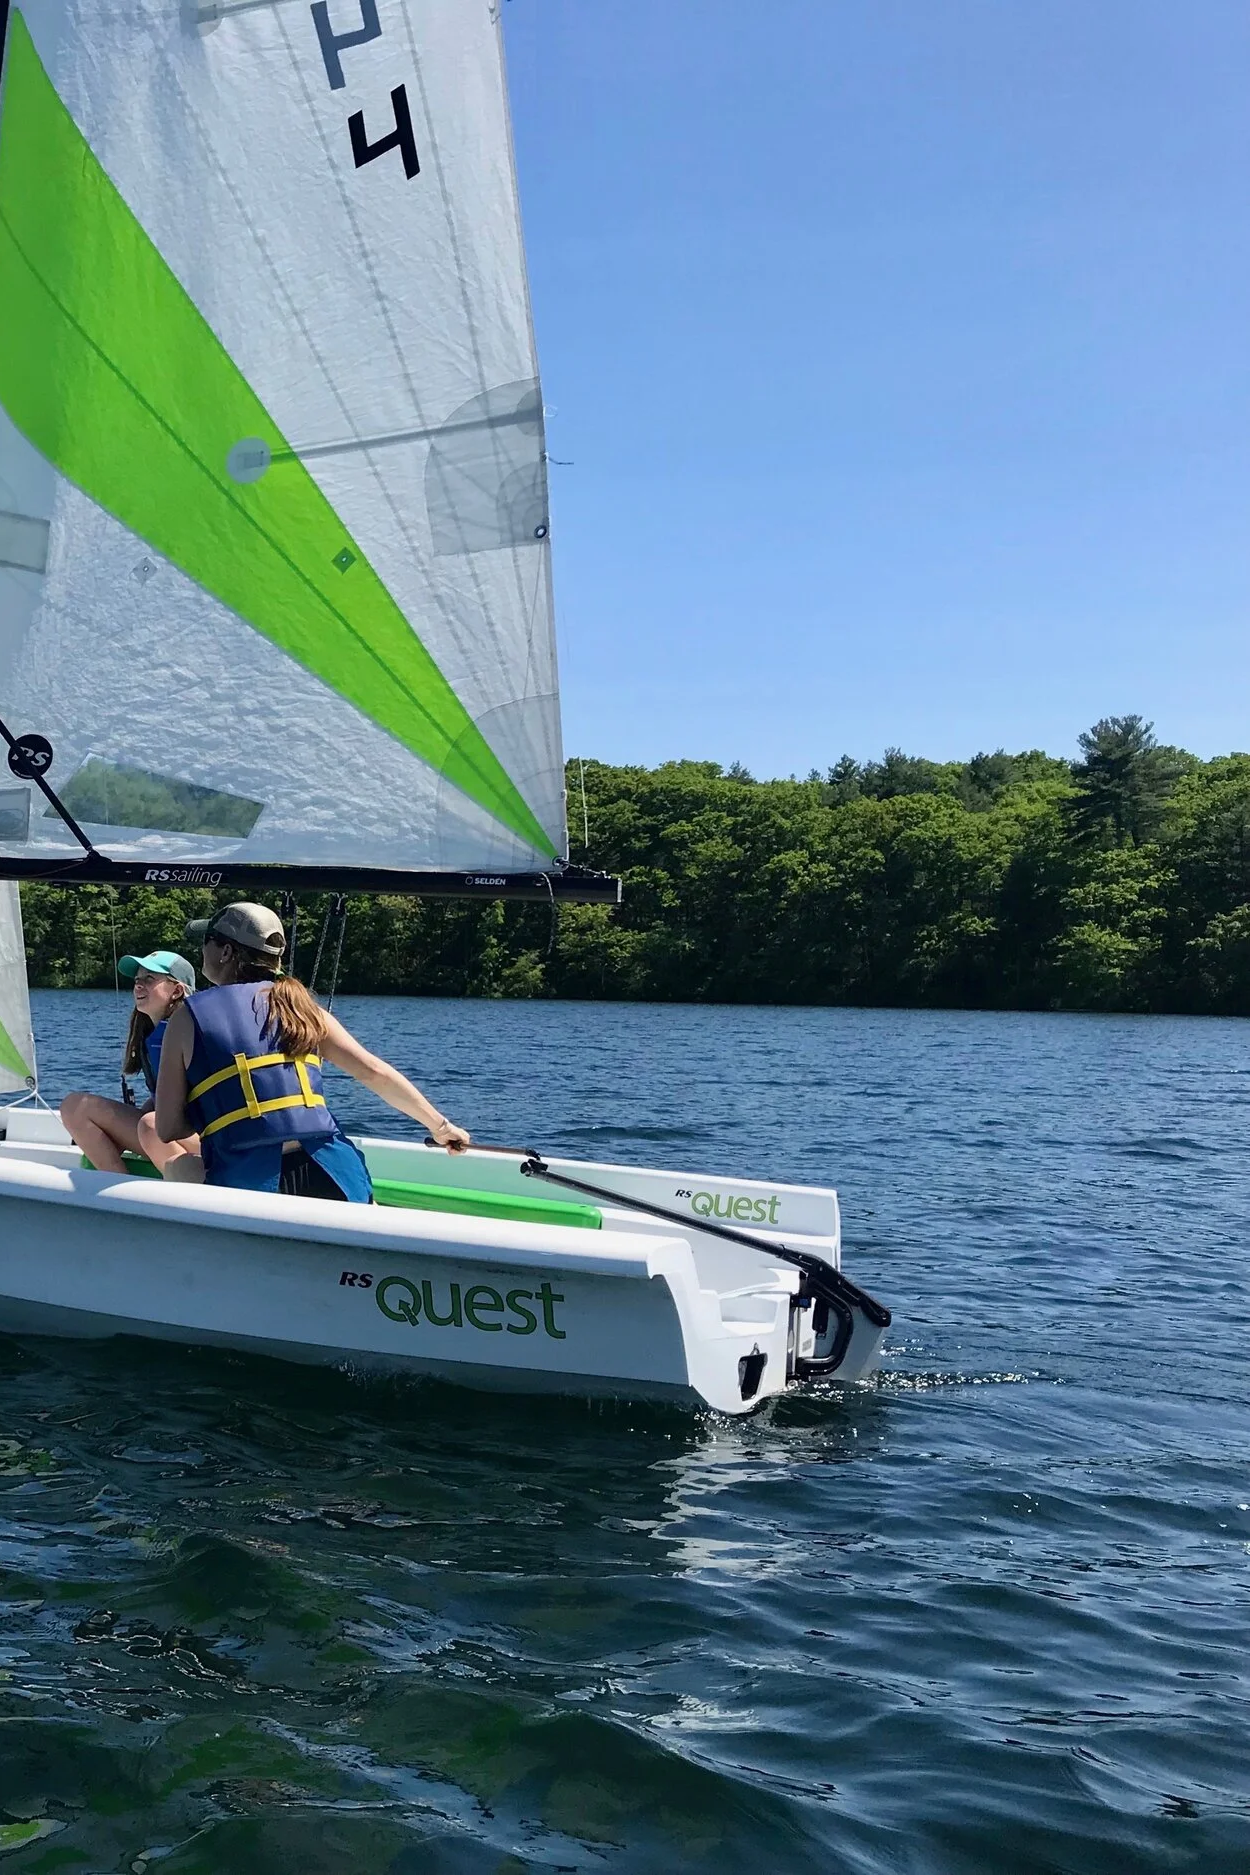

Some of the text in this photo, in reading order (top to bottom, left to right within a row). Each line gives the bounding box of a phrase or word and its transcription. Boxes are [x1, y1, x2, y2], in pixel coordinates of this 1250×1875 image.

[348, 83, 420, 181] 4
[675, 1189, 782, 1225] RS Quest
[339, 1271, 567, 1340] RS Quest
